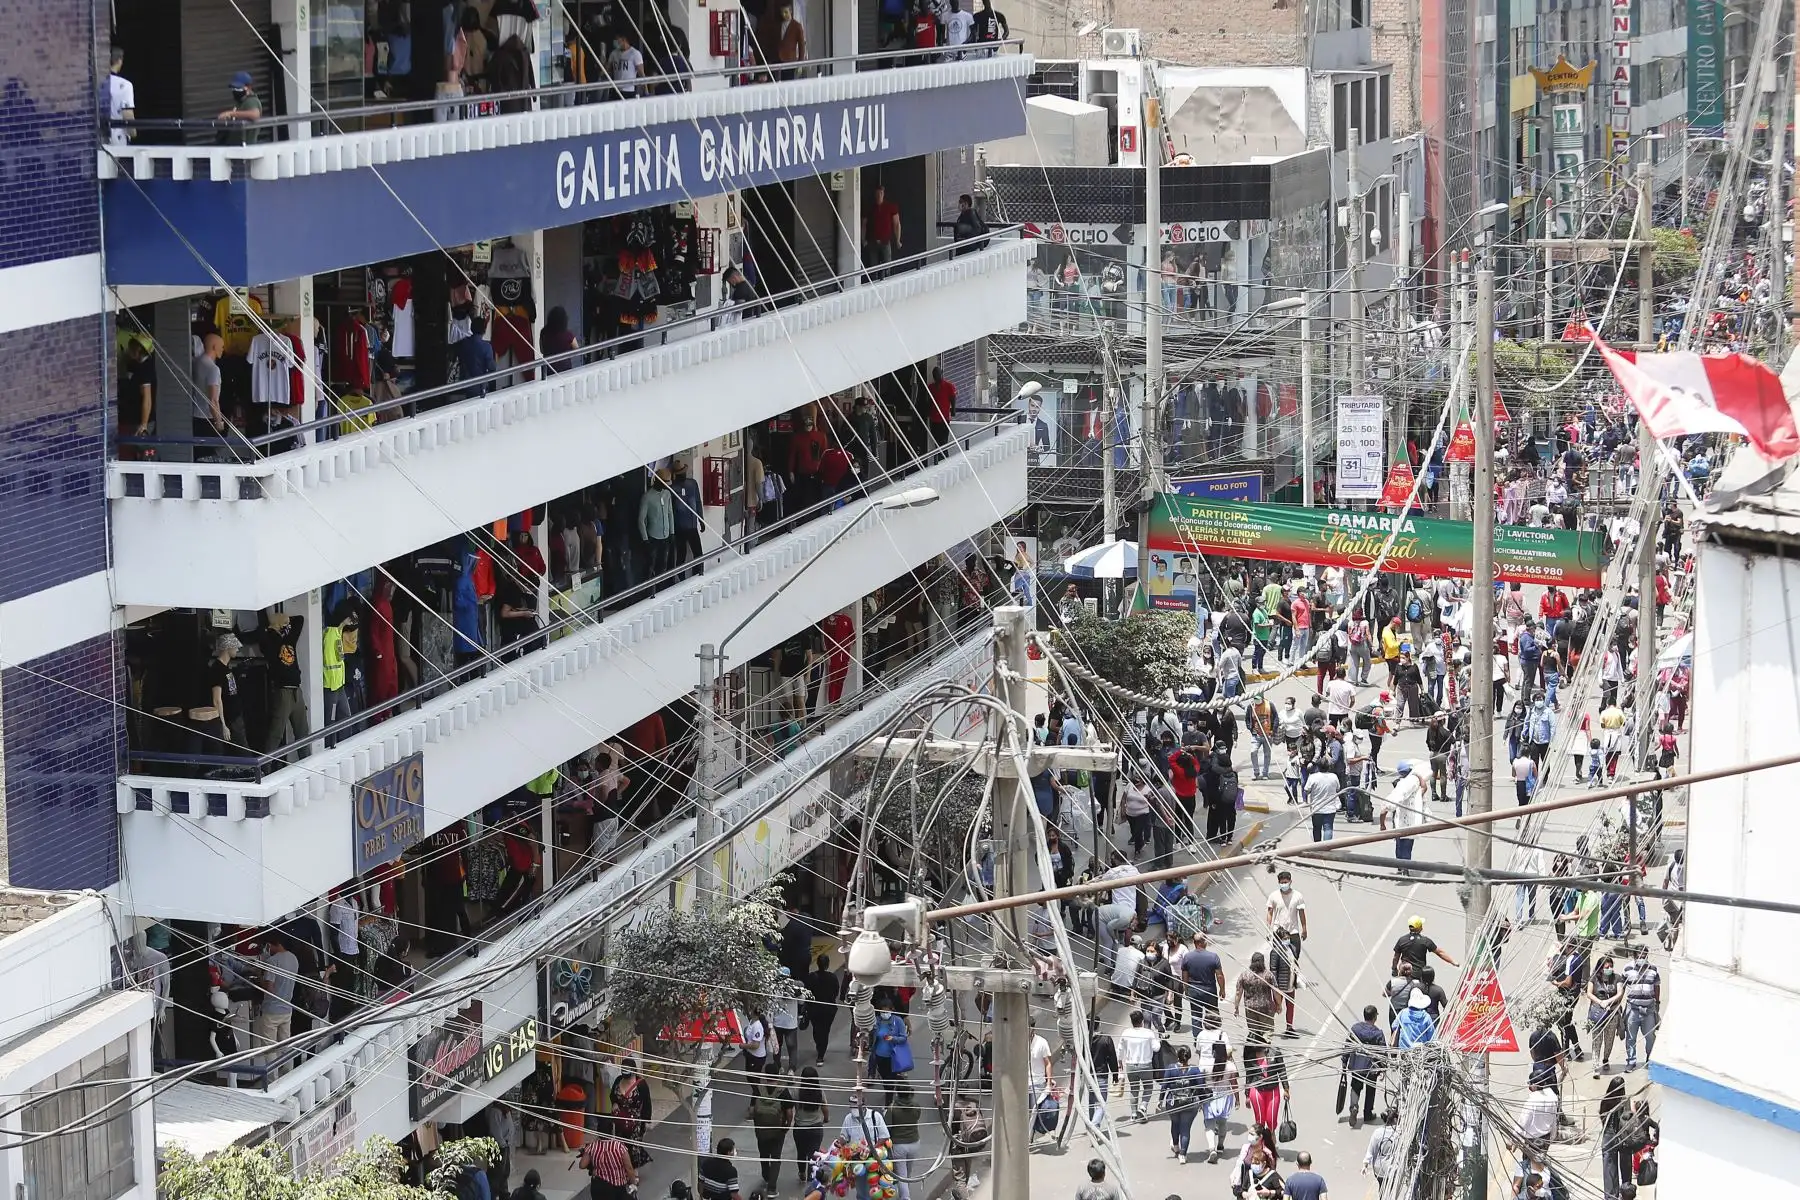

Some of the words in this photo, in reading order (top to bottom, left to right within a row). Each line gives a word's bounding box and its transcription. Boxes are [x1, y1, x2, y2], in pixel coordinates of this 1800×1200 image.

[1547, 72, 1579, 82] CENTRO
[1696, 45, 1716, 116] CENTRO
[1554, 109, 1582, 133] EL
[556, 133, 683, 209] GALERIA
[701, 112, 825, 182] GAMARRA
[839, 103, 889, 156] AZUL
[1345, 460, 1358, 470] 31
[1209, 483, 1229, 492] POLO
[1230, 481, 1248, 490] FOTO
[1191, 508, 1249, 523] PARTICIPA
[1180, 516, 1213, 526] Concurso
[1223, 520, 1262, 531] Decoración
[1262, 524, 1273, 532] de
[1220, 535, 1226, 543] A
[1227, 535, 1253, 546] CALLE
[1226, 529, 1261, 539] TIENDAS
[1321, 525, 1420, 559] Navidad
[1502, 563, 1522, 573] 924
[1524, 565, 1542, 574] 165
[1543, 566, 1563, 576] 980
[364, 833, 387, 860] FREE
[510, 1019, 537, 1063] FAS
